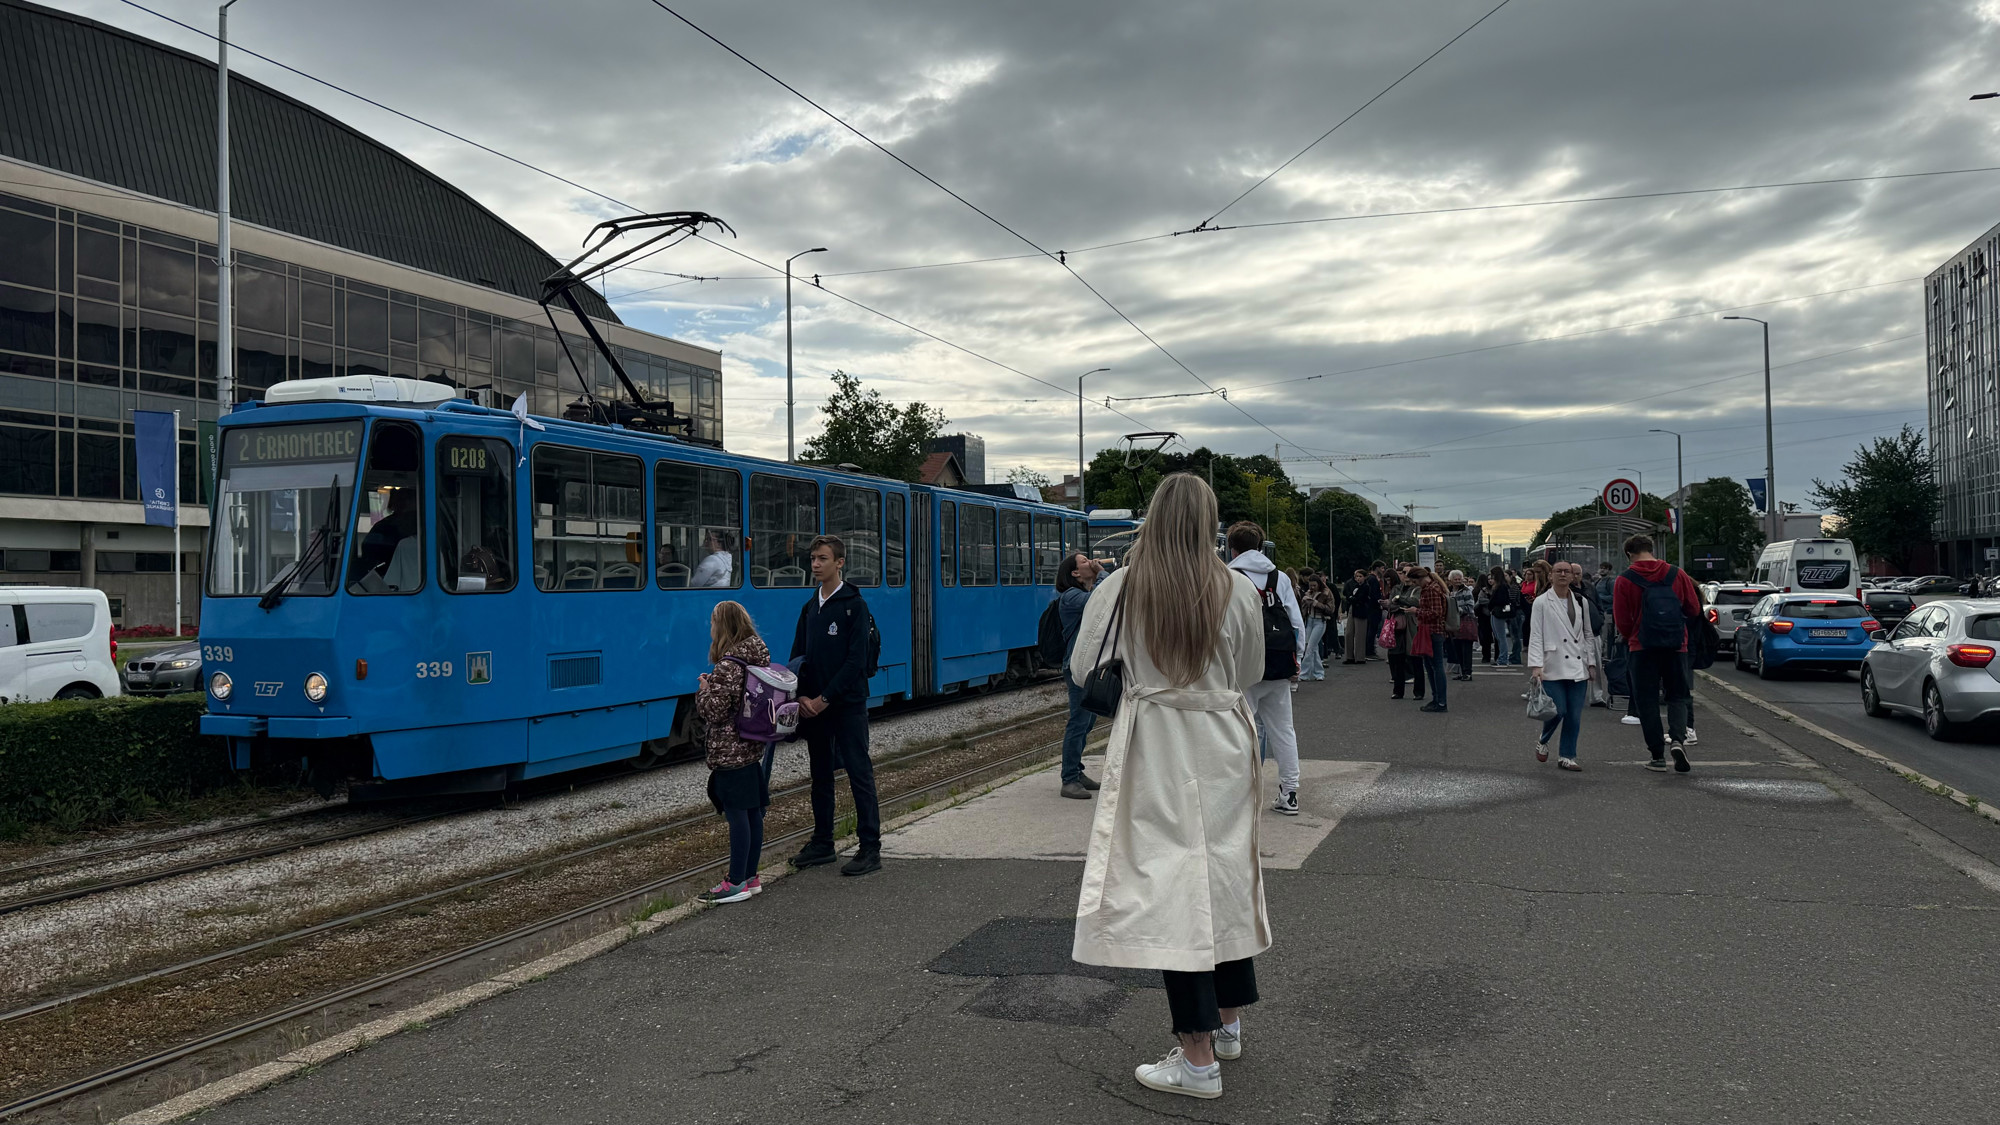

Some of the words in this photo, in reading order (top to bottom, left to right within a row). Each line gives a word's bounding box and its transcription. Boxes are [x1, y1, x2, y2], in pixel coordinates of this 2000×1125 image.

[240, 433, 249, 461] 2
[256, 430, 355, 460] ČRNOMEREC
[451, 447, 486, 469] 0208
[1611, 487, 1631, 505] 60
[1801, 564, 1847, 583] ZET
[204, 645, 234, 662] 339
[416, 661, 453, 678] 339
[254, 681, 284, 697] ZET
